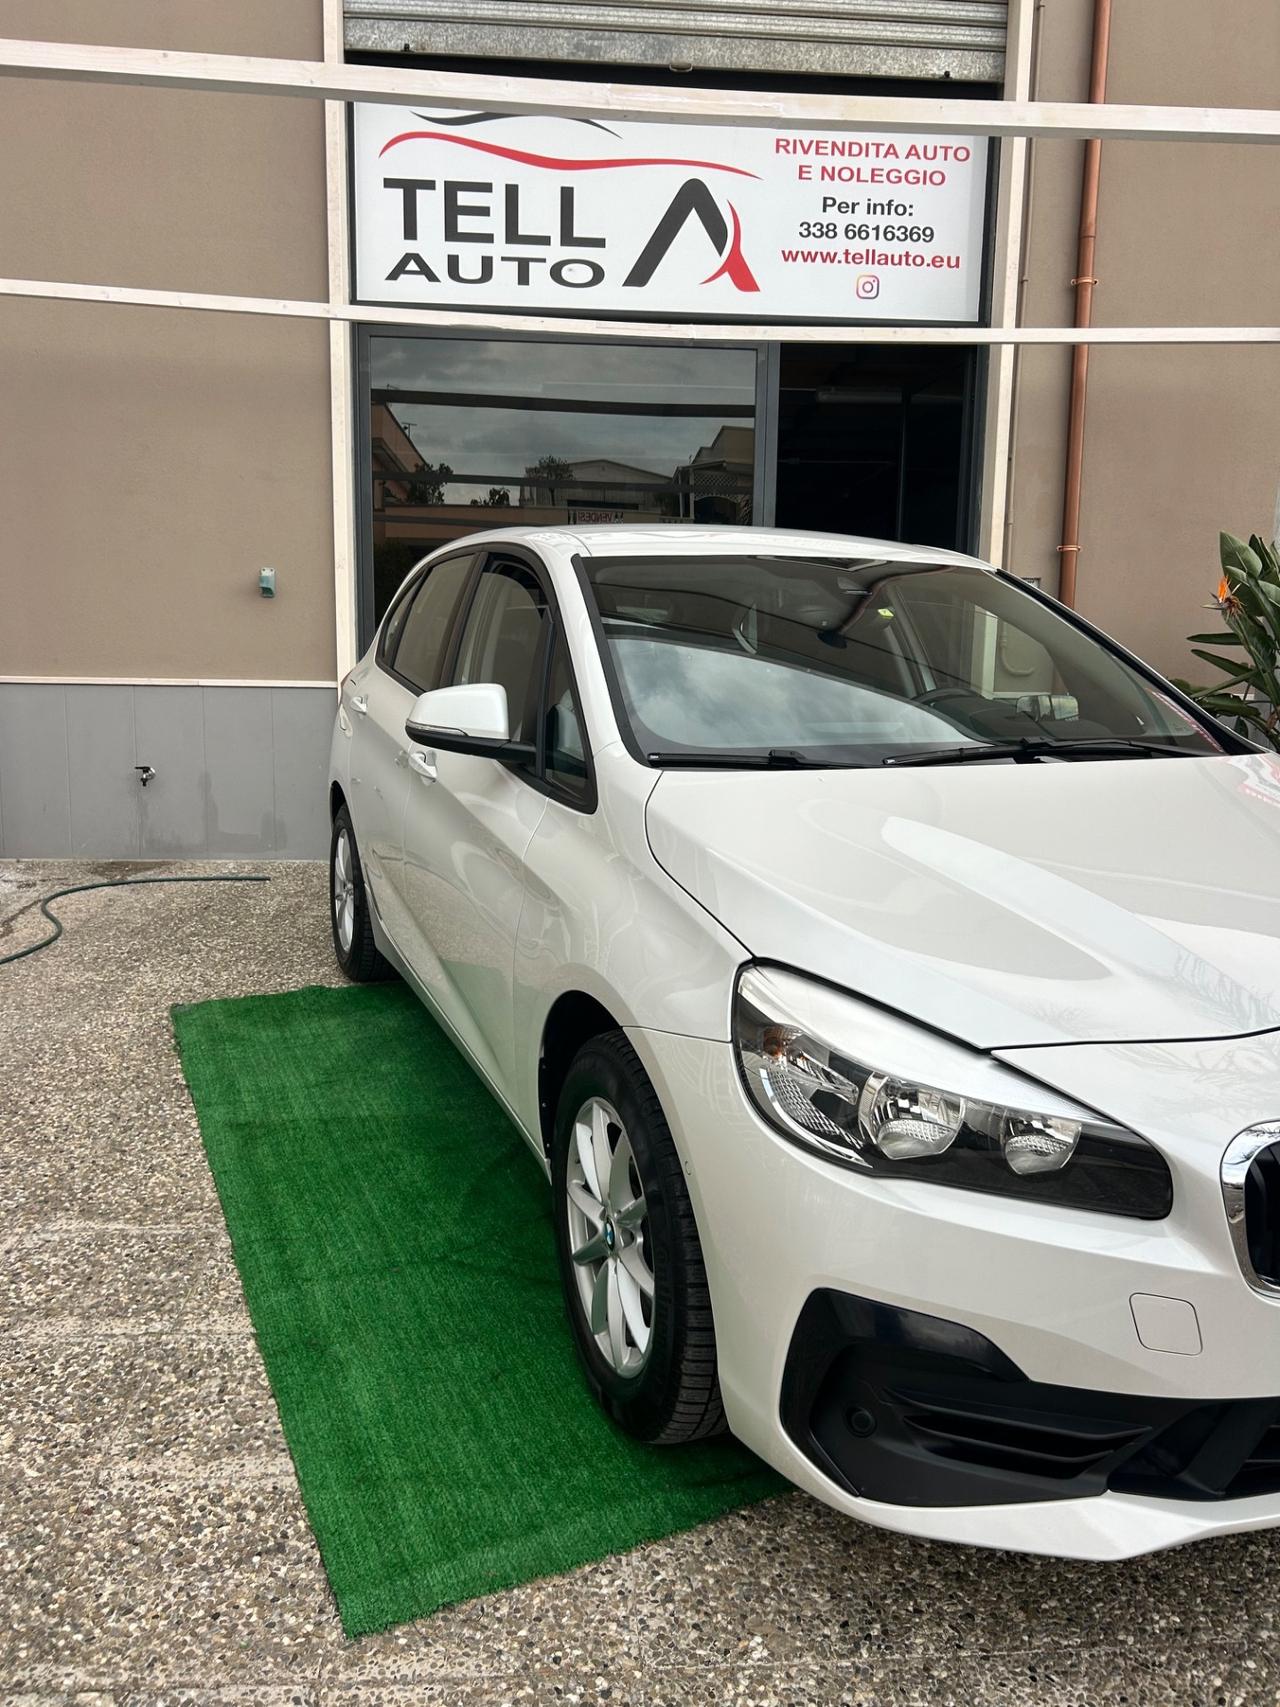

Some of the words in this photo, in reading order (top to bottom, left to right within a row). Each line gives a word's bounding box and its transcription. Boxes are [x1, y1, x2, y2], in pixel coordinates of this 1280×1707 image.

[775, 138, 900, 160] RIVENDITA
[904, 144, 971, 162] AUTO
[798, 164, 813, 181] E
[820, 166, 946, 186] NOLEGGIO
[383, 177, 606, 249] TELL
[822, 196, 860, 215] Per
[866, 198, 914, 216] info:
[798, 221, 838, 239] 338
[844, 223, 935, 243] 6616369
[781, 248, 961, 269] www.tellauto.eu
[384, 252, 606, 289] AUTO
